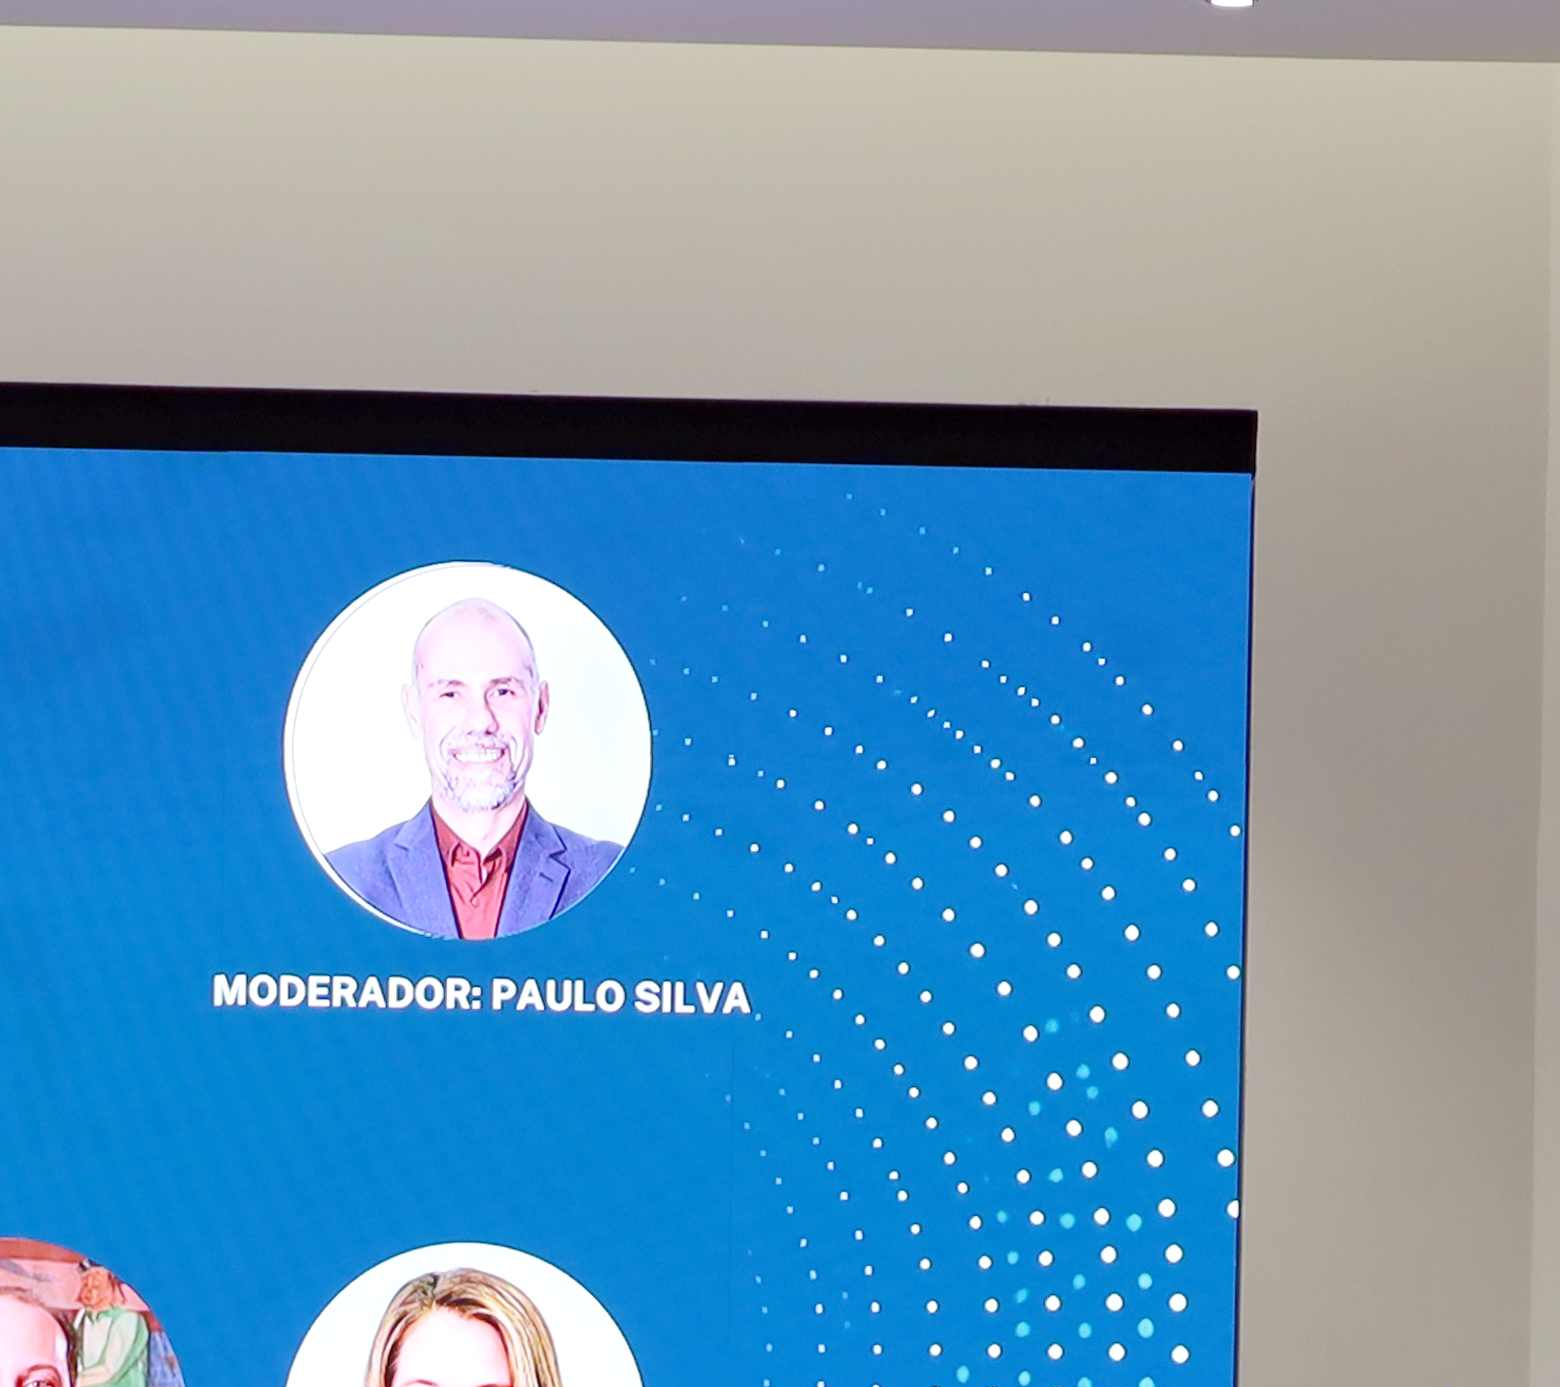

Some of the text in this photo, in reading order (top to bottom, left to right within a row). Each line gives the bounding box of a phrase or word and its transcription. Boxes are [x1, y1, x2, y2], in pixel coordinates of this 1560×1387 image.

[213, 973, 752, 1014] MODERADOR: PAULO SILVA
